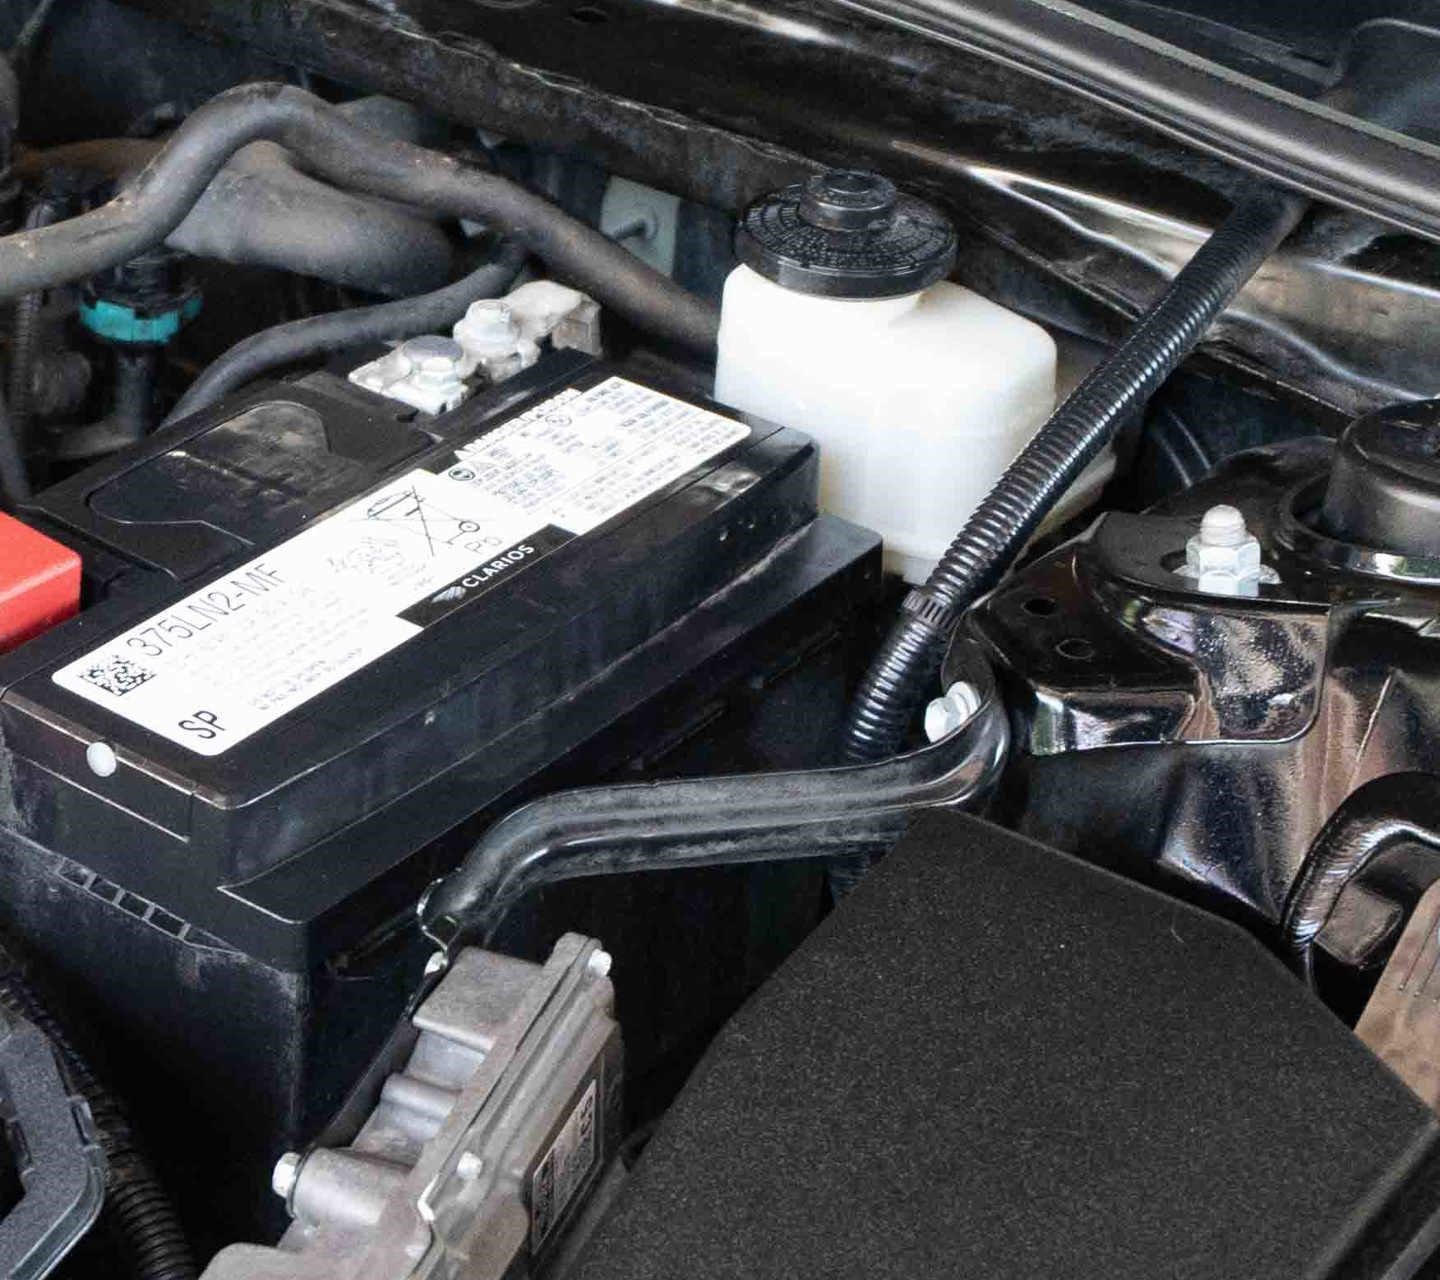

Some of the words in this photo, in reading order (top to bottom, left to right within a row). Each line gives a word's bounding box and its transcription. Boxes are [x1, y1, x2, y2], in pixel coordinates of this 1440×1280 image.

[461, 544, 535, 589] CLARIOS
[126, 563, 285, 657] 375LN2-MF
[178, 710, 226, 740] SP
